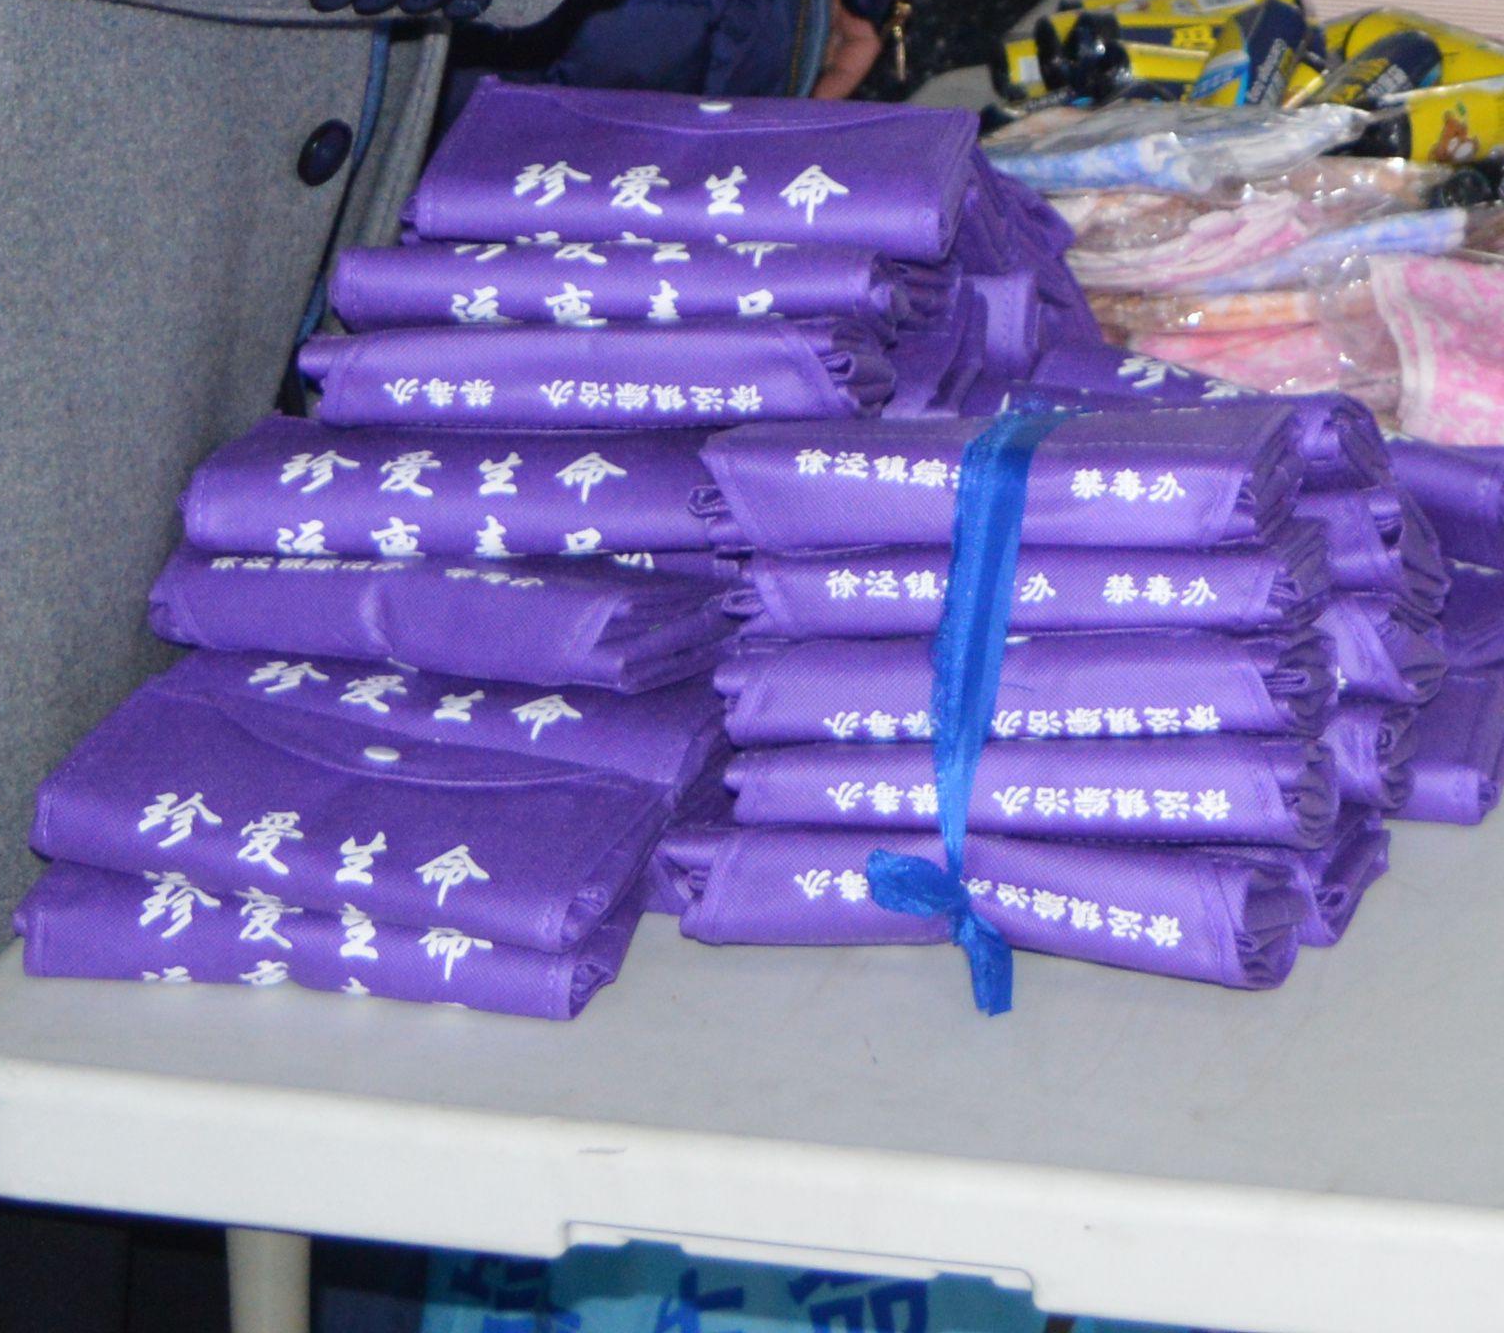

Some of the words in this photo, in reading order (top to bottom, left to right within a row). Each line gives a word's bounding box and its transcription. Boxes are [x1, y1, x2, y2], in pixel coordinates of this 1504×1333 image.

[513, 160, 849, 224] 珍爱生命
[383, 378, 495, 406] 禁毒办
[540, 378, 763, 412] 徐泾镇综治办
[279, 448, 628, 503] 珍爱生命
[1070, 467, 1187, 503] 禁毒办
[1102, 573, 1219, 607] 禁毒办
[248, 660, 583, 741] 珍爱生命
[992, 781, 1232, 821] 徐泾镇综治办
[138, 790, 490, 907] 珍爱生命
